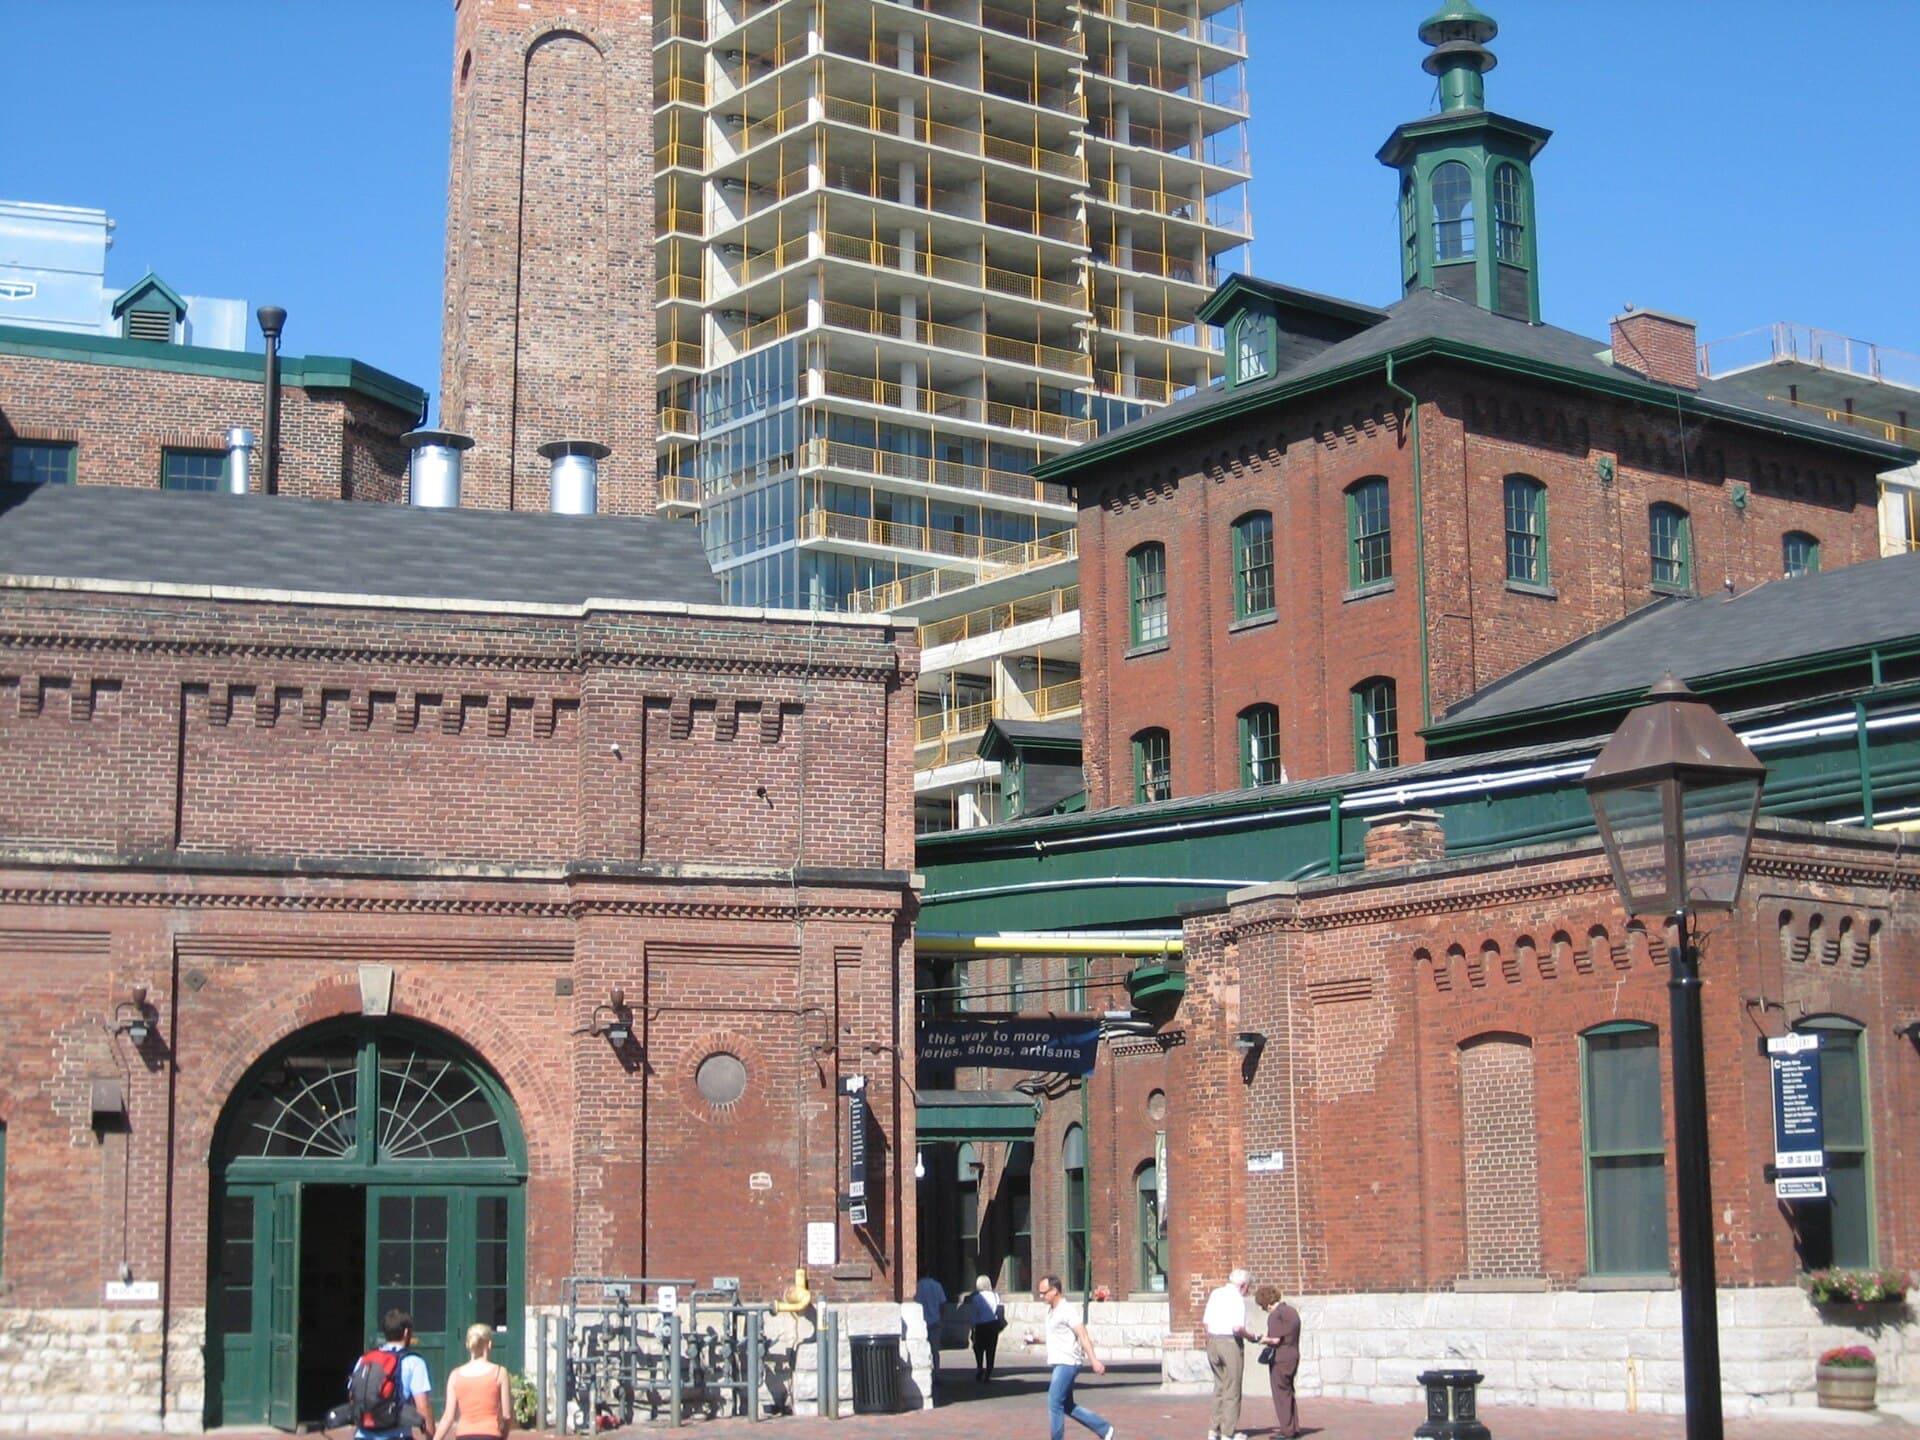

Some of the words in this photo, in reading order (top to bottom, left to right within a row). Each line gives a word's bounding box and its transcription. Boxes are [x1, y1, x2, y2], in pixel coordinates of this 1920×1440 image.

[928, 1033, 956, 1045] this
[961, 1030, 988, 1043] way
[993, 1030, 1008, 1042] to
[1013, 1032, 1050, 1043] more
[968, 1043, 1015, 1058] shops,
[1020, 1045, 1081, 1060] artisans
